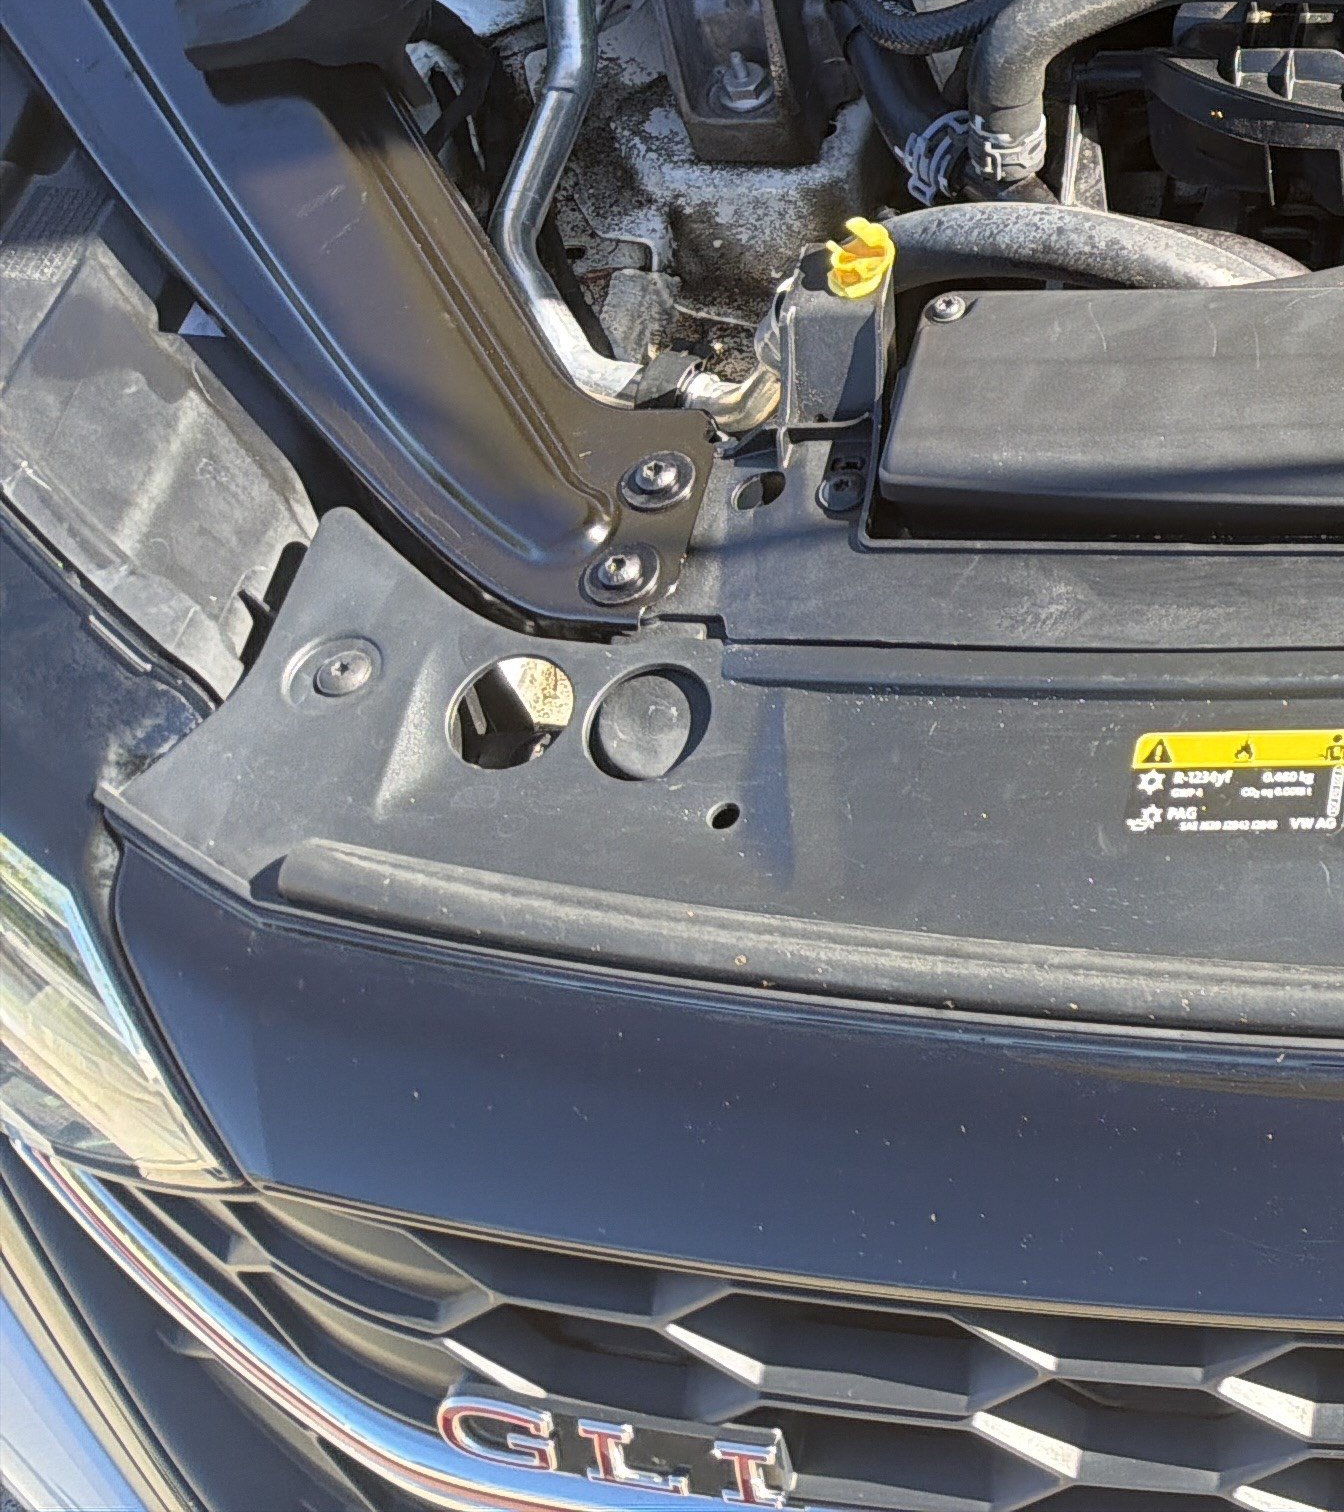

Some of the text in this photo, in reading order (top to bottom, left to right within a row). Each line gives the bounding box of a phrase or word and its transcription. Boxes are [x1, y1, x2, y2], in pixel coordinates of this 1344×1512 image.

[1173, 770, 1233, 787] R-1234yf
[1166, 807, 1198, 820] PAG
[1289, 817, 1337, 830] VW AG
[437, 1395, 788, 1510] GLI
